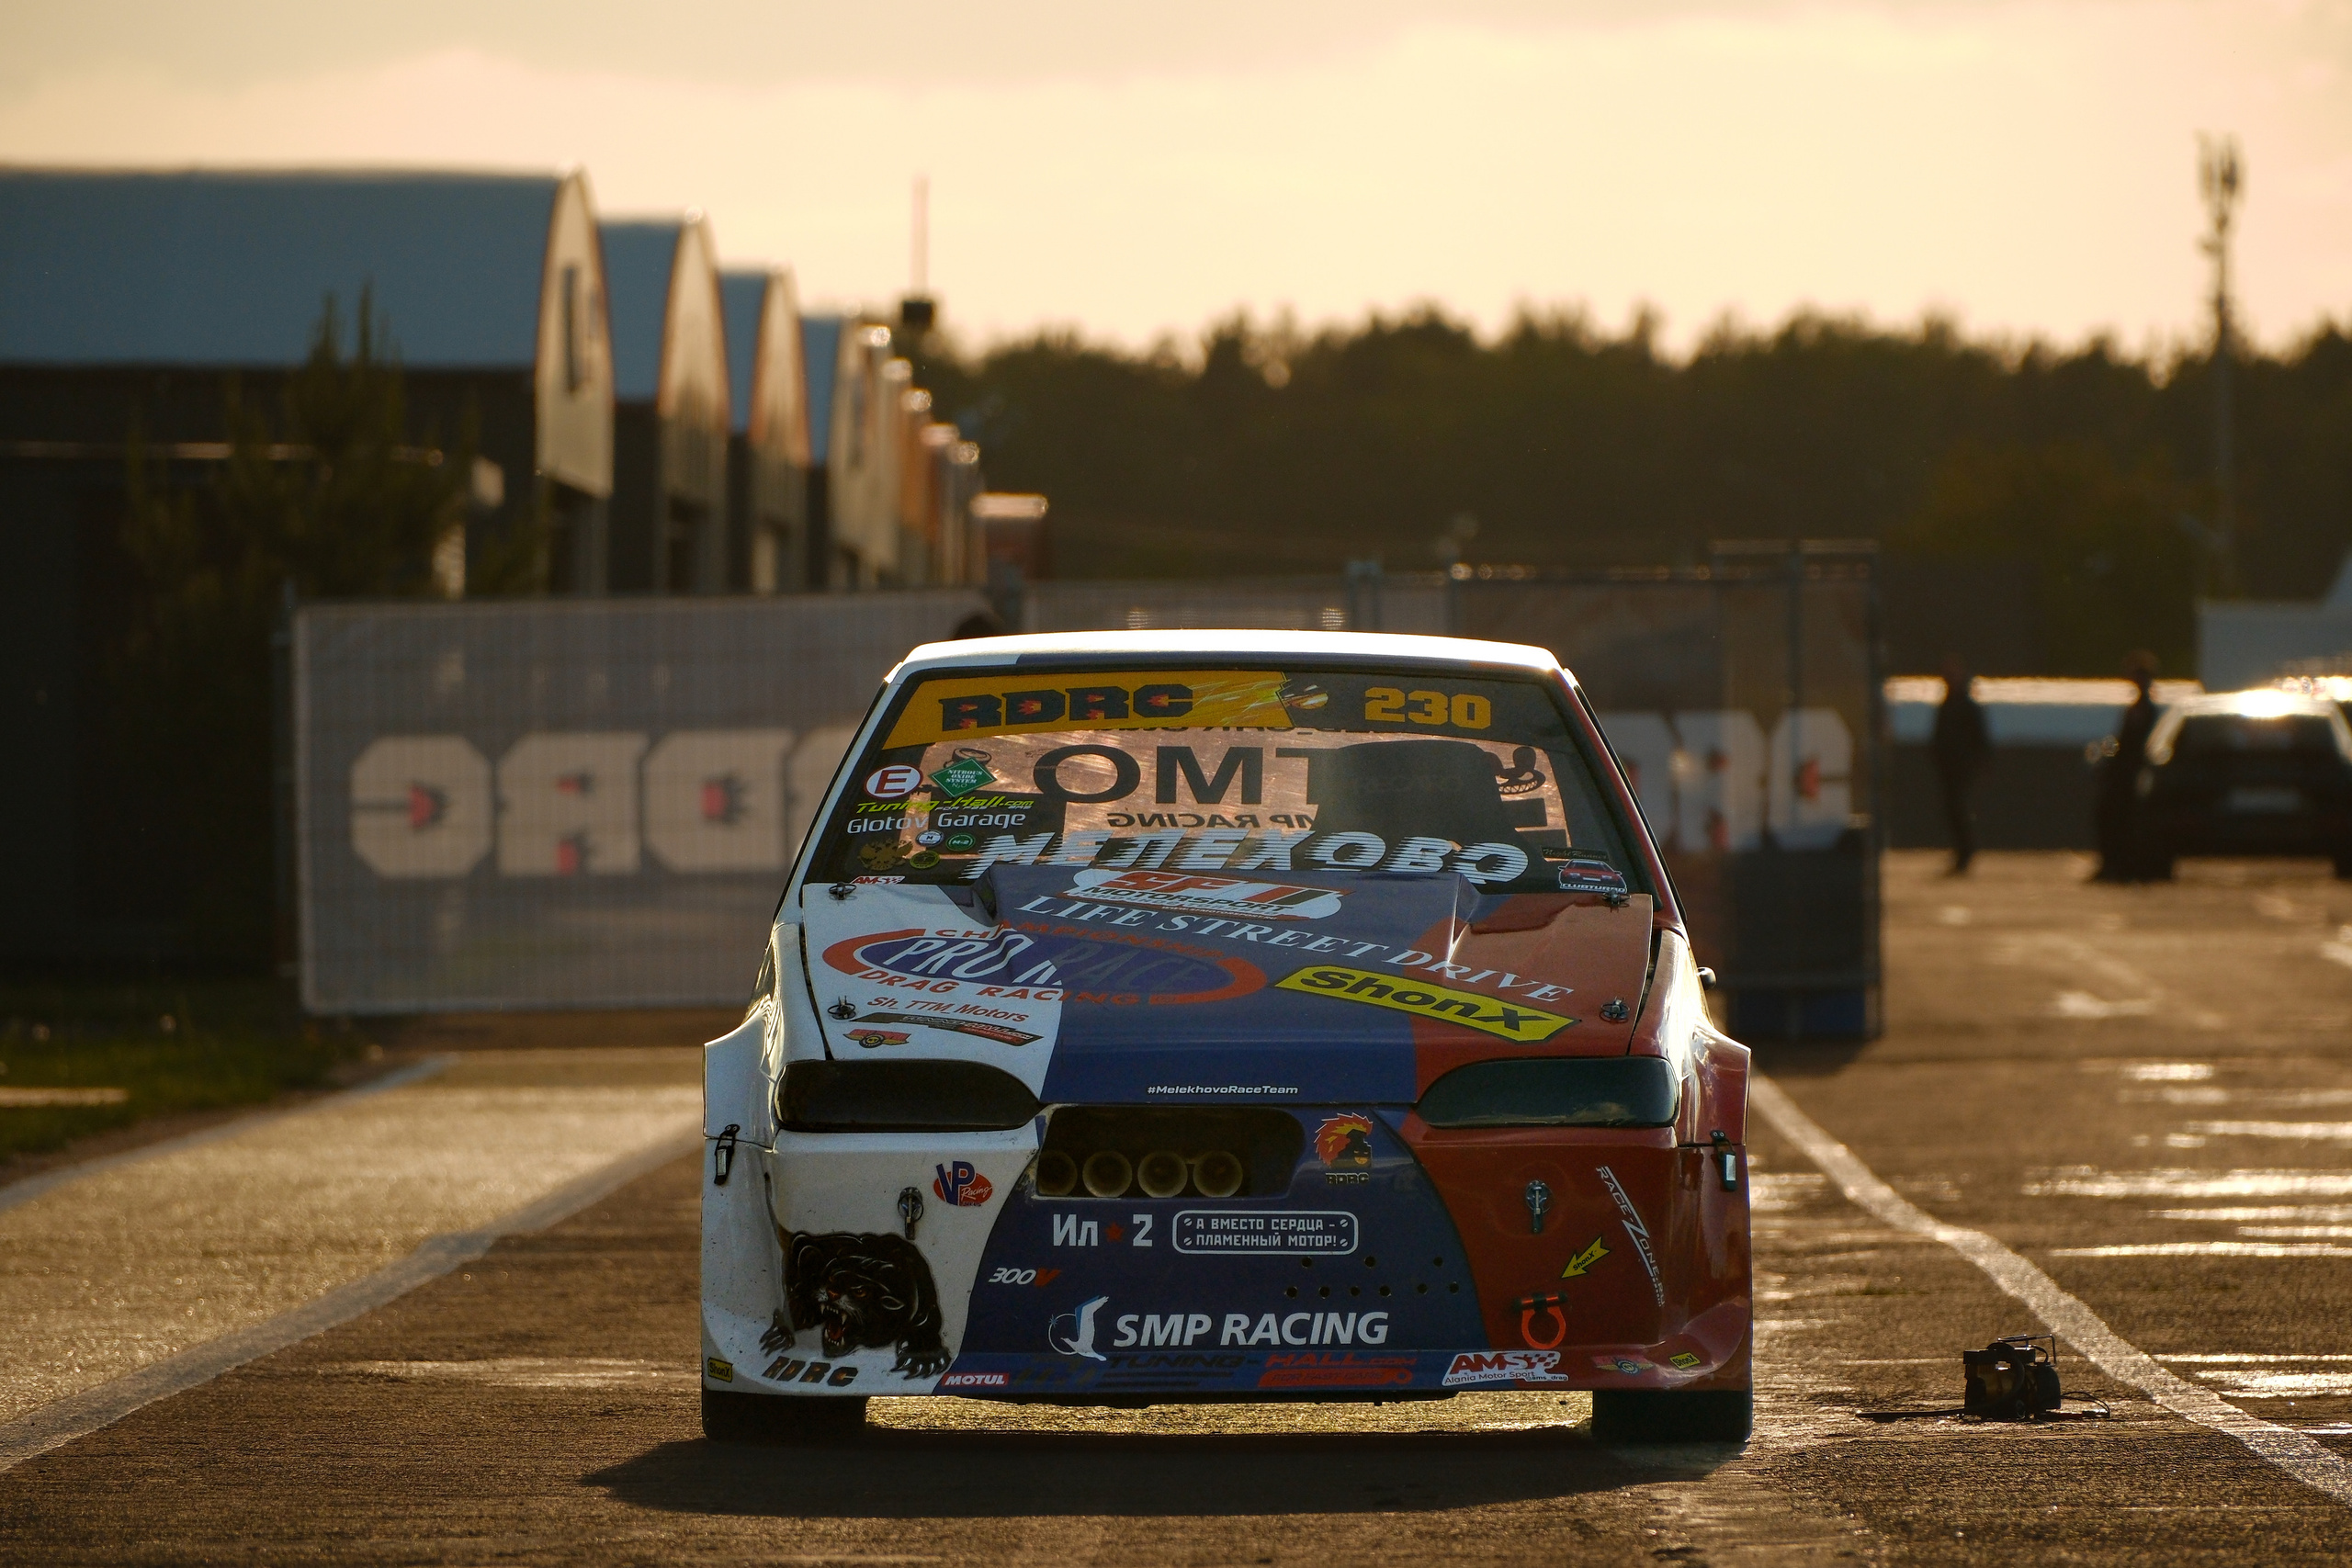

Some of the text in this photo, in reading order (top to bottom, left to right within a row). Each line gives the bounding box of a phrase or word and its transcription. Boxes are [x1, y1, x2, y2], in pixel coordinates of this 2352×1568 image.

[938, 684, 1193, 731] RDRC
[1365, 686, 1491, 729] 230
[876, 769, 911, 794] E
[846, 812, 1026, 834] Glotov Garage
[1082, 887, 1295, 911] MOTORSPORT
[884, 930, 1036, 979] PRO
[1014, 895, 1574, 1003] LIFE STREET DRIVE
[857, 969, 1141, 1007] DRAG RACING
[1300, 969, 1555, 1032] ShonX
[1147, 1085, 1298, 1094] #MelekhovoRaceTeam
[936, 1161, 975, 1206] VP
[961, 1185, 993, 1201] Racing
[1053, 1213, 1153, 1247] Ил 2
[1196, 1219, 1204, 1230] А
[1211, 1219, 1264, 1231] ВМЕСТО
[1271, 1219, 1324, 1233] СЕРДЦА
[1196, 1232, 1337, 1247] ПЛАМЕННЫЙ МОТОР!
[1573, 1250, 1595, 1271] ShonX
[1114, 1311, 1390, 1348] SMP RACING
[709, 1363, 731, 1379] ShonX
[762, 1356, 858, 1386] RDRC
[944, 1374, 1005, 1385] MOTUL
[1444, 1372, 1476, 1384] Alania
[1510, 1371, 1535, 1380] Sport
